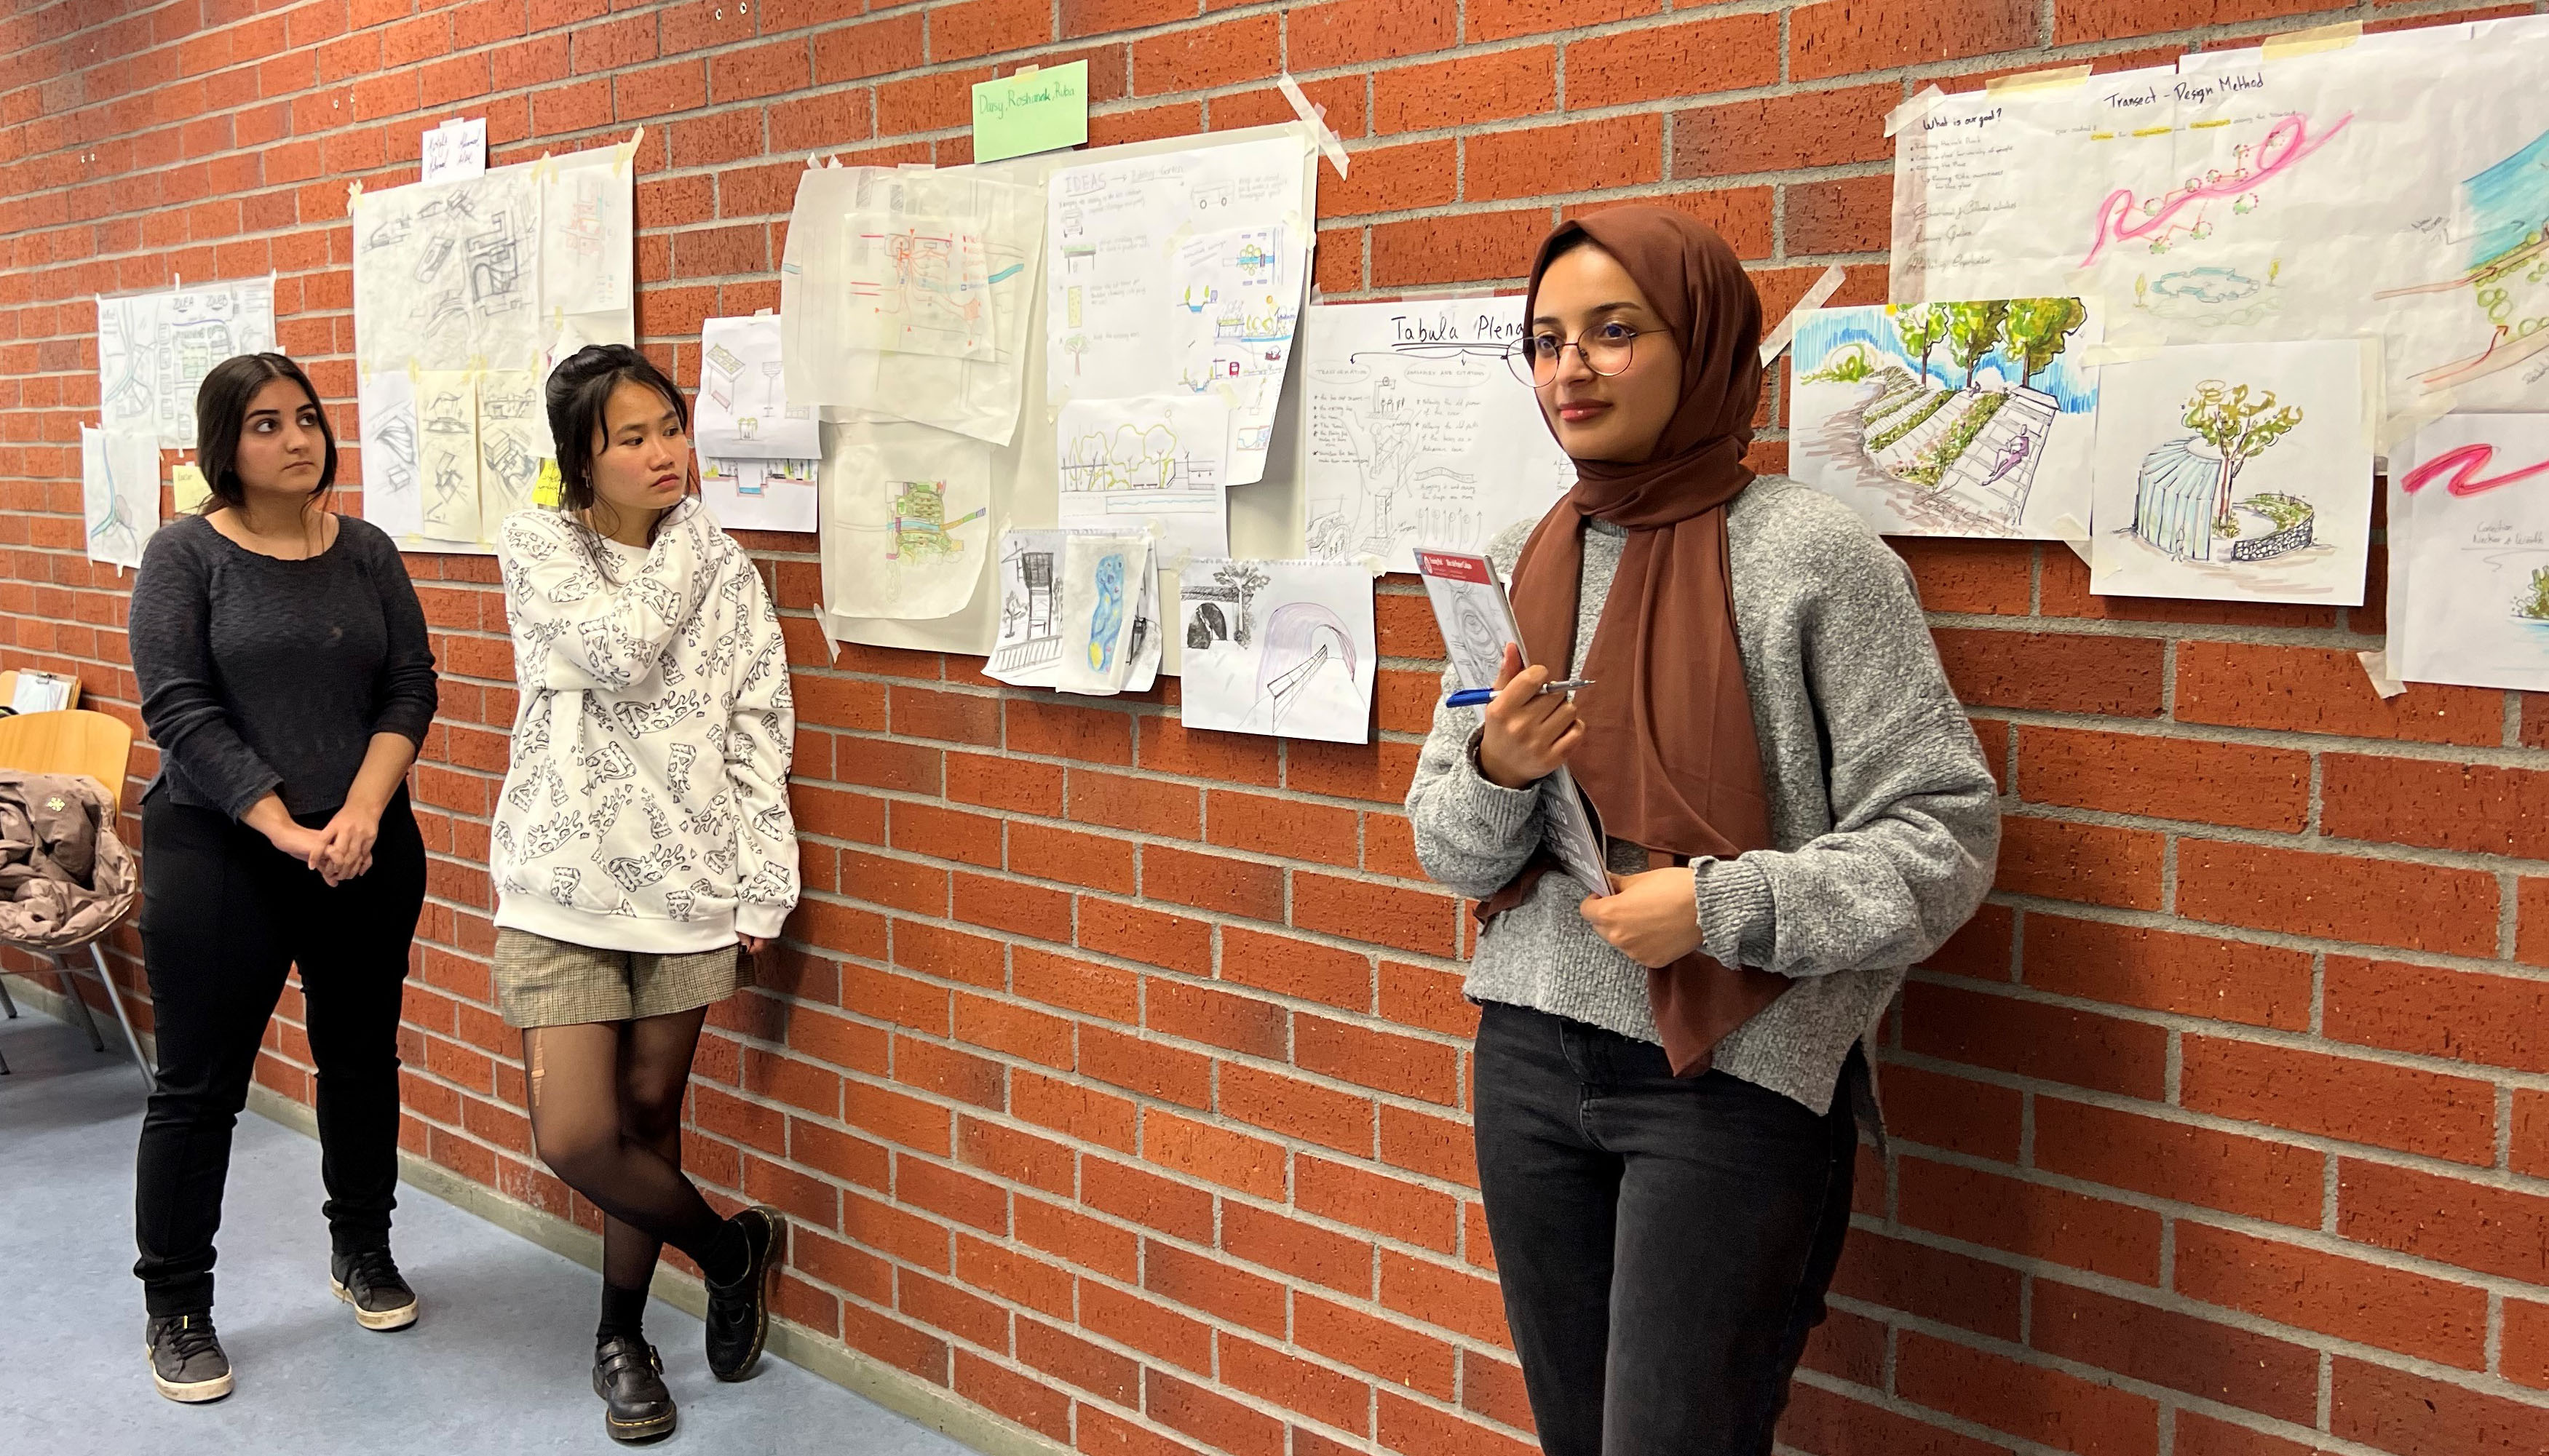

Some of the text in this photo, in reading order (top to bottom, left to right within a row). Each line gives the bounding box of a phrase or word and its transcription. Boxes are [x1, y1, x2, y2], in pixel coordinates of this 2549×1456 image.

[2104, 86, 2157, 109] Transect
[2173, 81, 2214, 104] Design
[2219, 72, 2264, 92] Method
[1922, 116, 1948, 131] What
[1953, 116, 1961, 127] is
[1065, 172, 1106, 194] IDEAS
[1391, 314, 1523, 343] Tabula Plena
